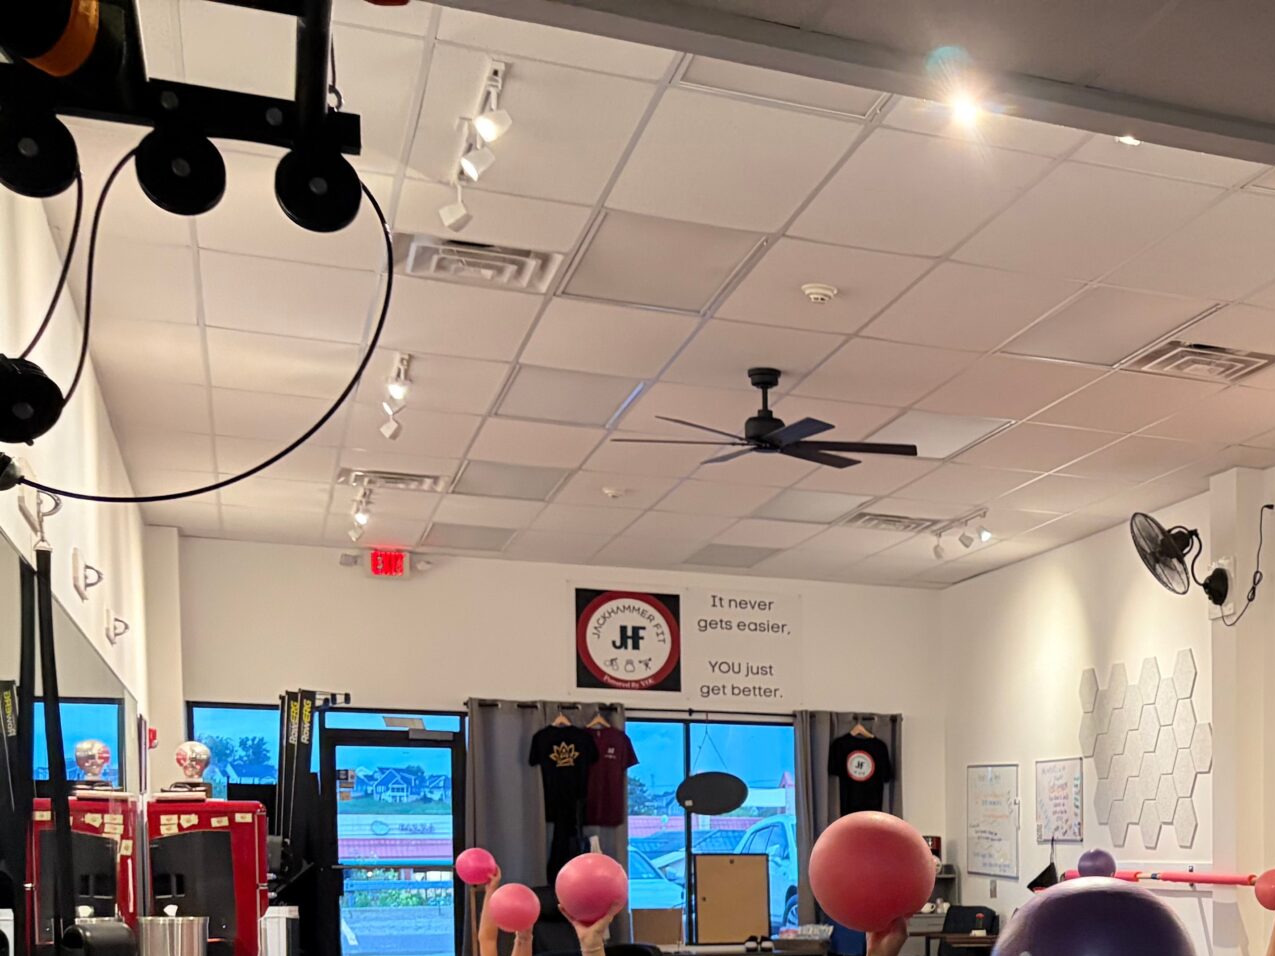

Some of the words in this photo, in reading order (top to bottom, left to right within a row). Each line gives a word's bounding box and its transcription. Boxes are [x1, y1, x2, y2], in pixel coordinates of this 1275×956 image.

[711, 594, 724, 608] It
[728, 598, 774, 611] never
[592, 604, 656, 639] JACKHAMMER
[653, 623, 666, 644] FIT
[697, 618, 733, 632] gets
[737, 620, 791, 636] easier,
[612, 625, 646, 650] JHF
[708, 660, 741, 674] YOU
[745, 662, 774, 678] just
[699, 684, 726, 698] get
[731, 683, 784, 698] better.
